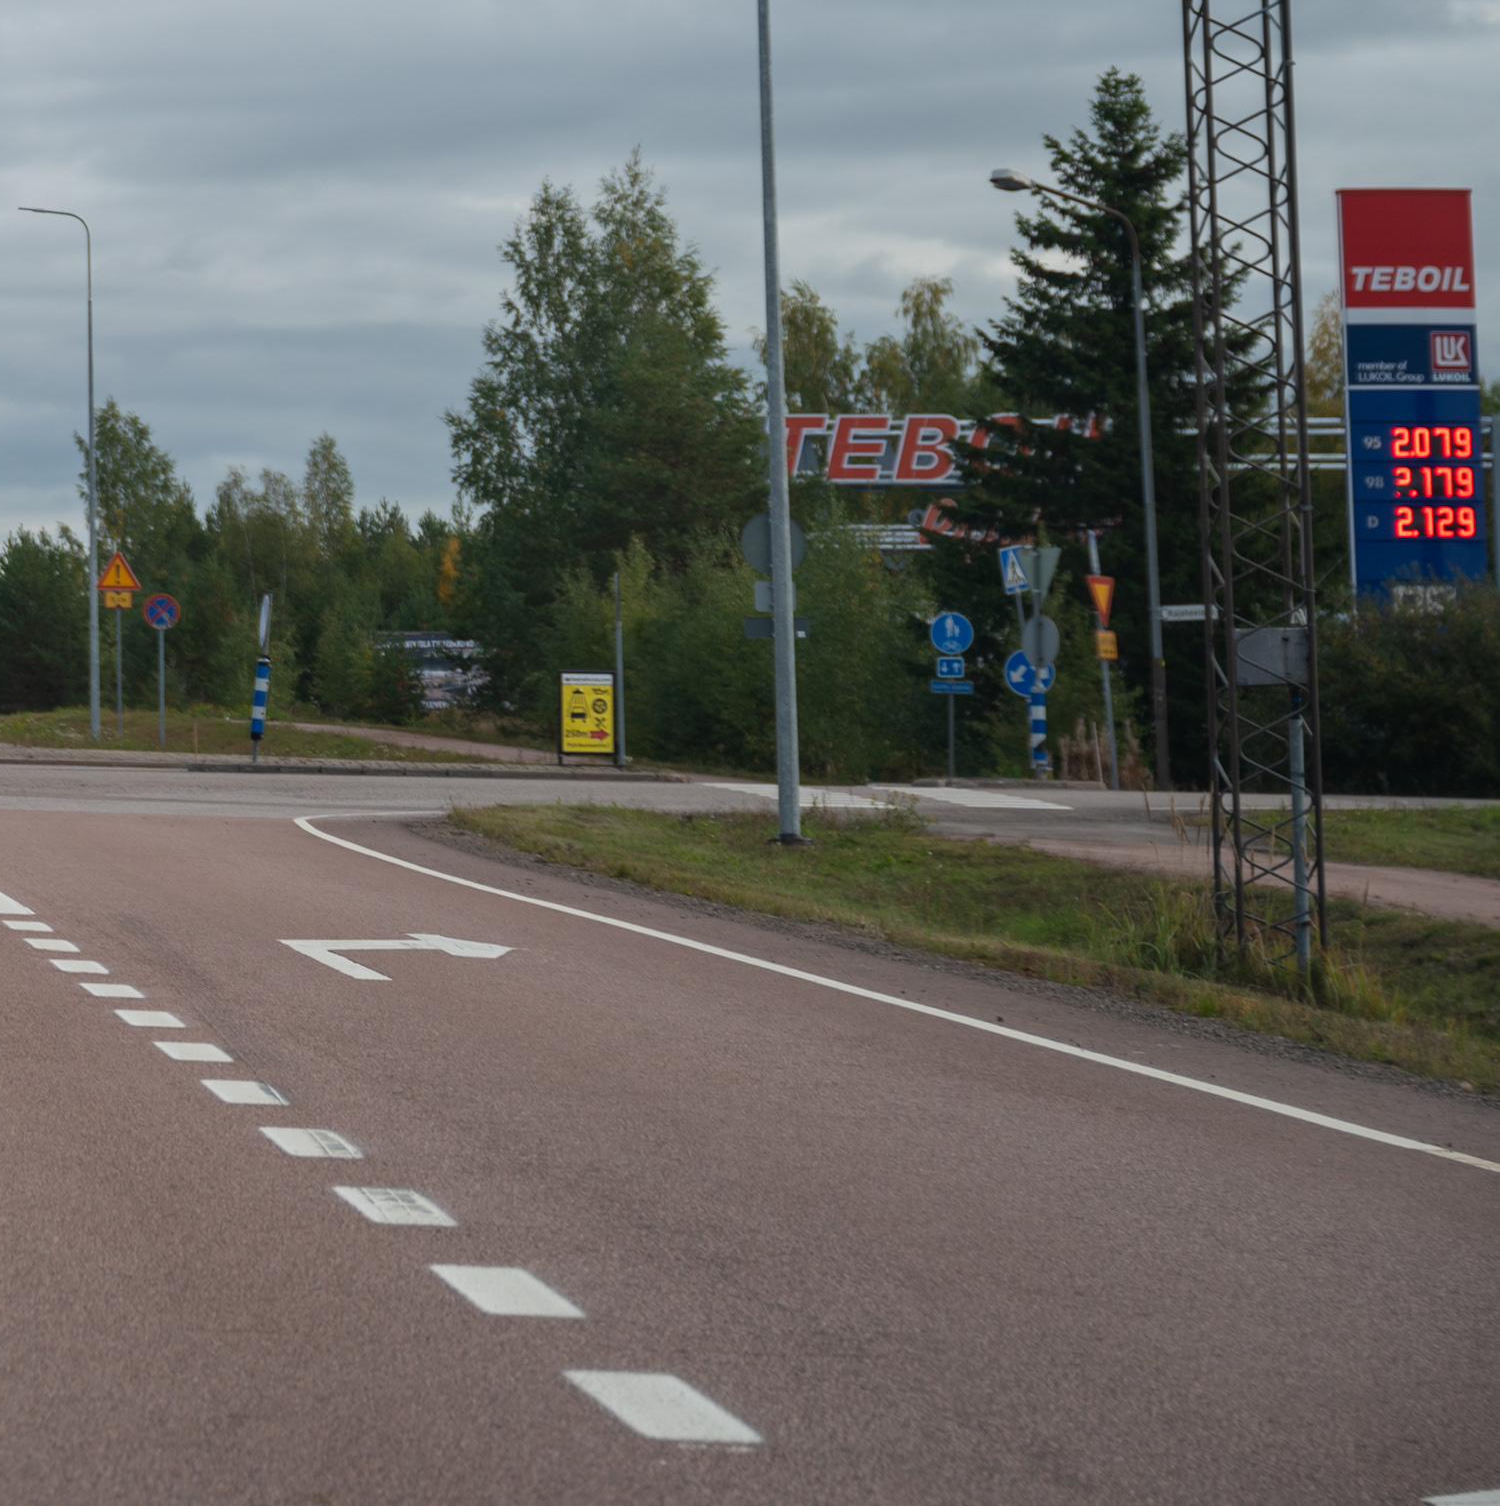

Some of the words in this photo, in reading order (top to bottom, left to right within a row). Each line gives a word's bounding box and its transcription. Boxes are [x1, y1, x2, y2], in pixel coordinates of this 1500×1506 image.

[1350, 265, 1470, 292] TEBOIL
[1358, 361, 1396, 371] member
[1397, 360, 1408, 371] of
[1358, 372, 1396, 383] LUKOIL
[1396, 371, 1425, 383] Group
[1432, 371, 1471, 382] LUKOIL
[1363, 436, 1382, 450] 95
[1391, 426, 1472, 459] 2.079
[1365, 476, 1384, 489] 98
[1394, 506, 1476, 538] 2.129
